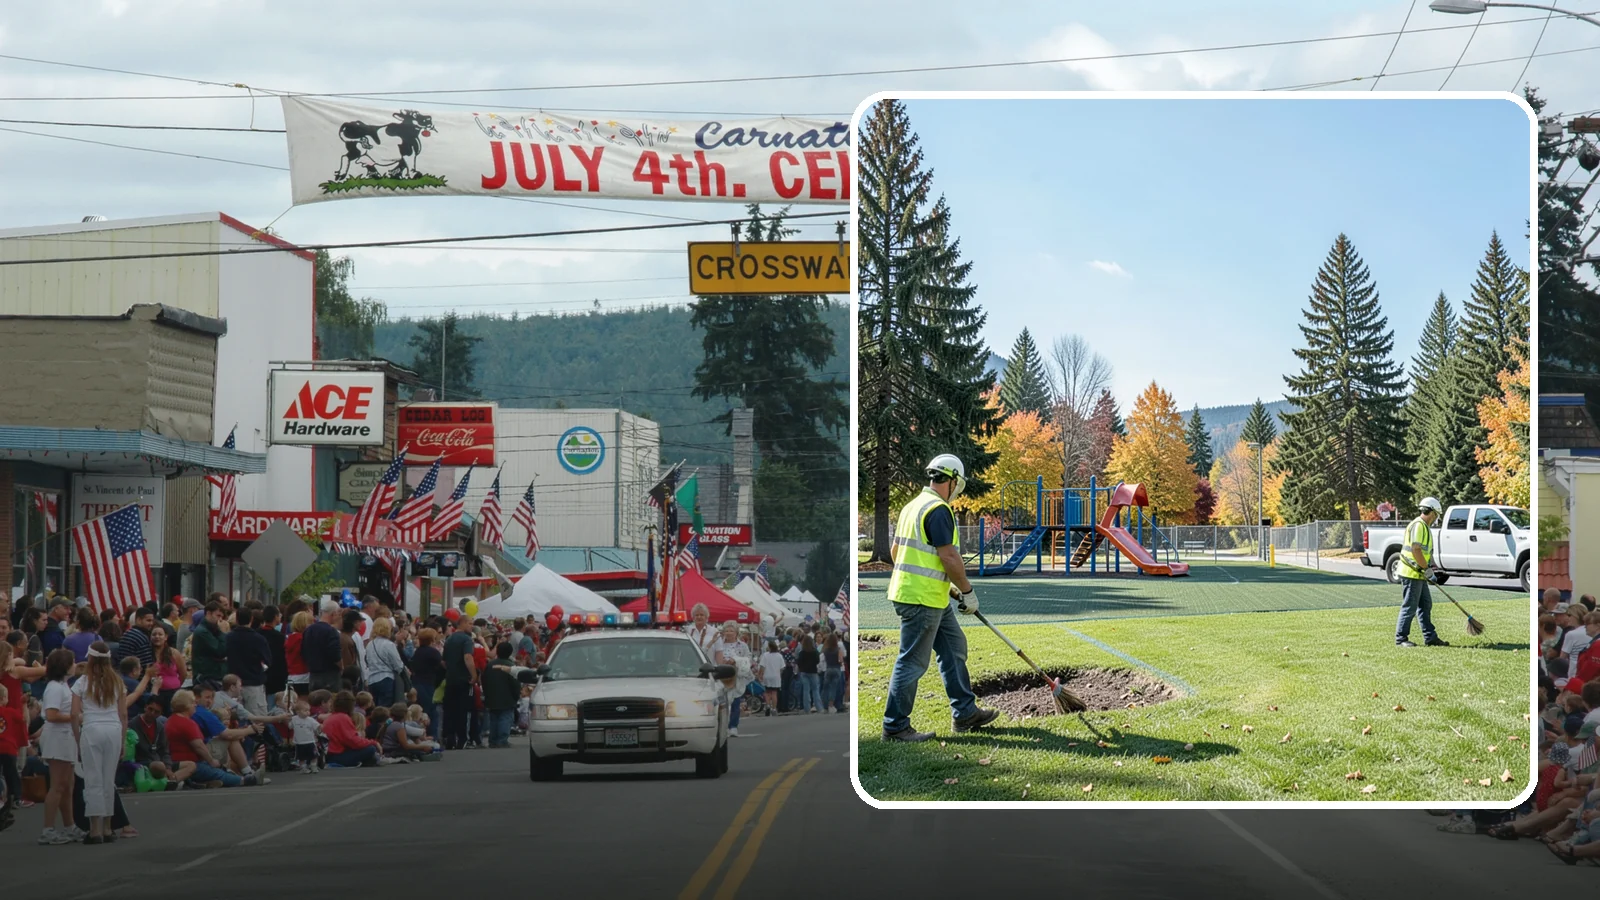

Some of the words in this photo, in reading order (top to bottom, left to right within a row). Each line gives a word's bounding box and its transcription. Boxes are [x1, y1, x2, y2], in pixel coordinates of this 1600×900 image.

[481, 140, 605, 192] JULY
[632, 150, 746, 198] 4th.
[697, 254, 850, 280] CROSSWA
[283, 380, 373, 420] ACE
[406, 409, 452, 421] CEDAR
[461, 409, 485, 421] LOG
[283, 420, 370, 437] Hardware
[416, 427, 476, 447] Coca-Cola
[353, 467, 384, 480] Simpl
[83, 486, 93, 494] St.
[96, 485, 124, 494] Vincent
[126, 486, 136, 494] de
[138, 486, 155, 495] Paul
[688, 526, 741, 535] CRNATION
[699, 535, 730, 543] GLASS
